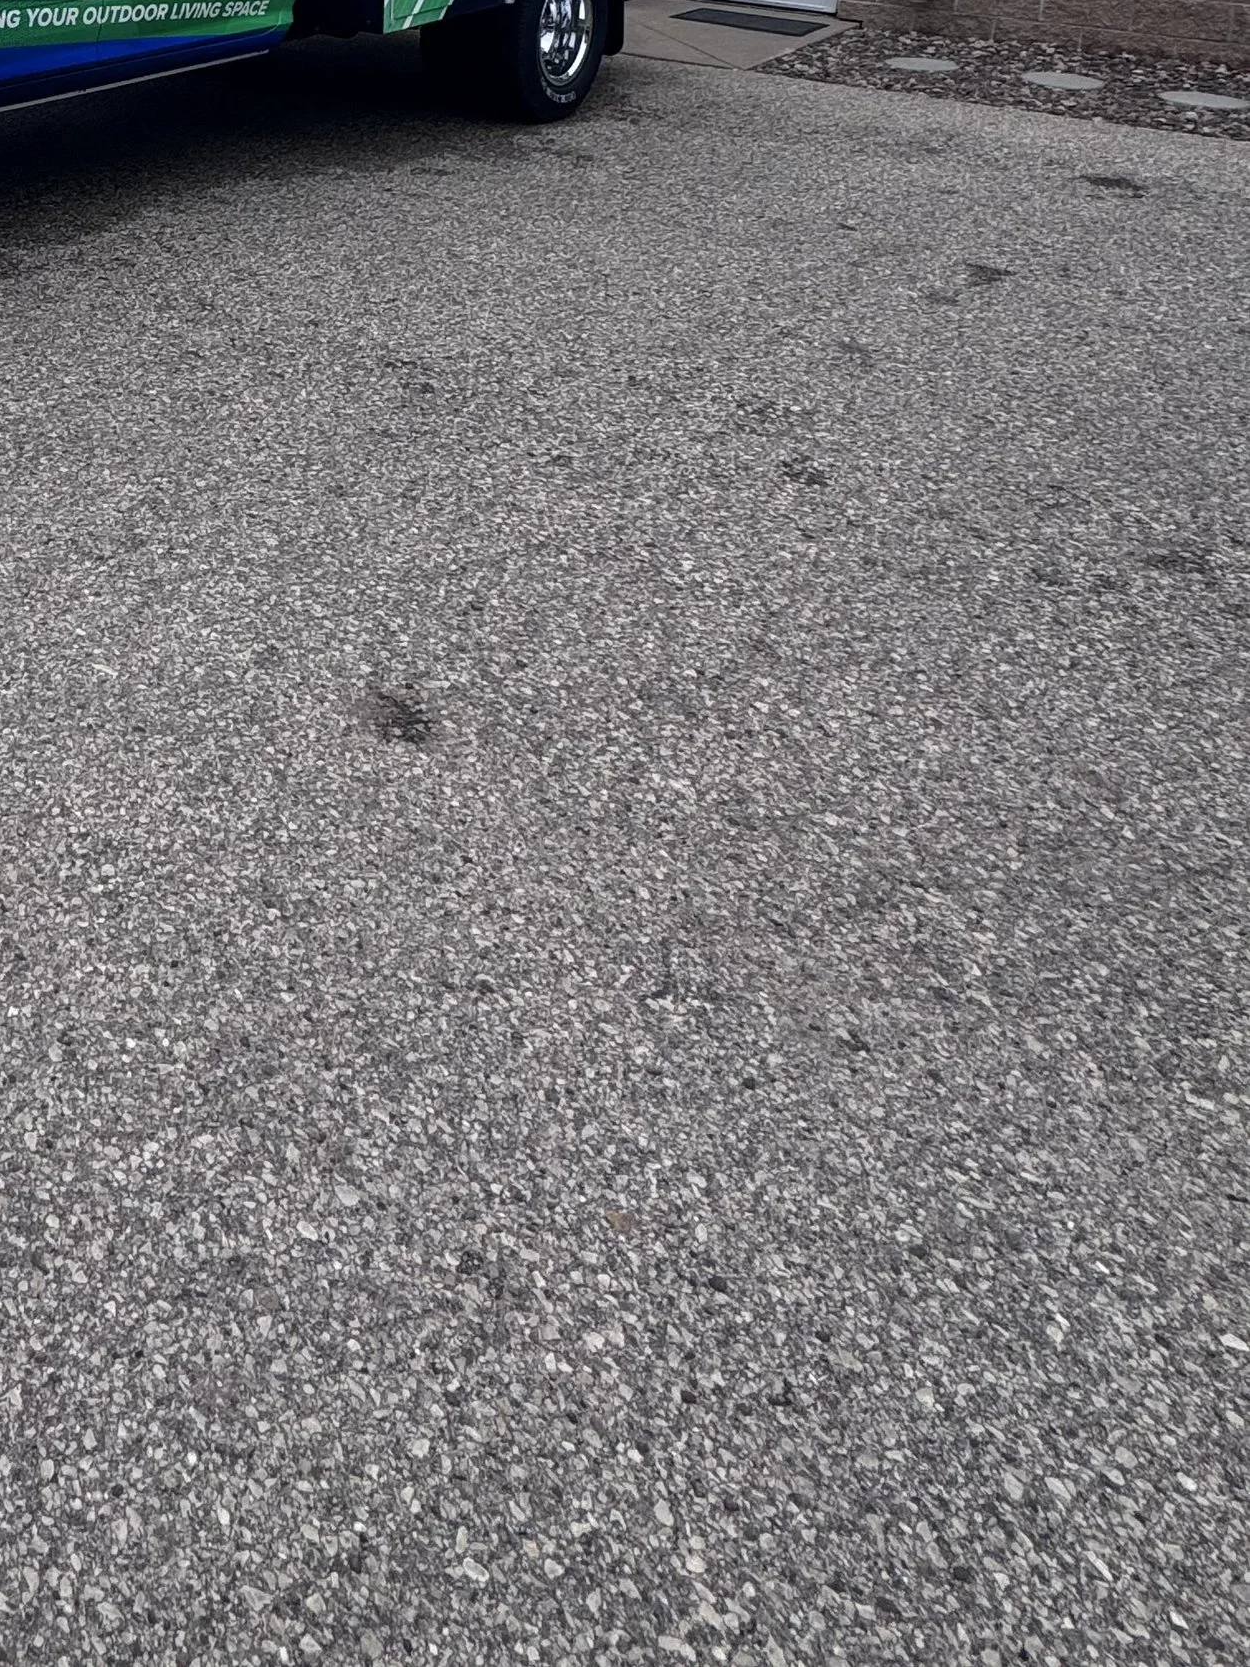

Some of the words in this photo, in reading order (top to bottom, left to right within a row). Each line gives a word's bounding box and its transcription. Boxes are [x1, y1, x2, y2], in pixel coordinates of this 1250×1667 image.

[26, 7, 80, 26] YOUR
[82, 3, 169, 26] OUTDOOR
[170, 3, 222, 20] LIVING
[222, 0, 270, 18] SPACE
